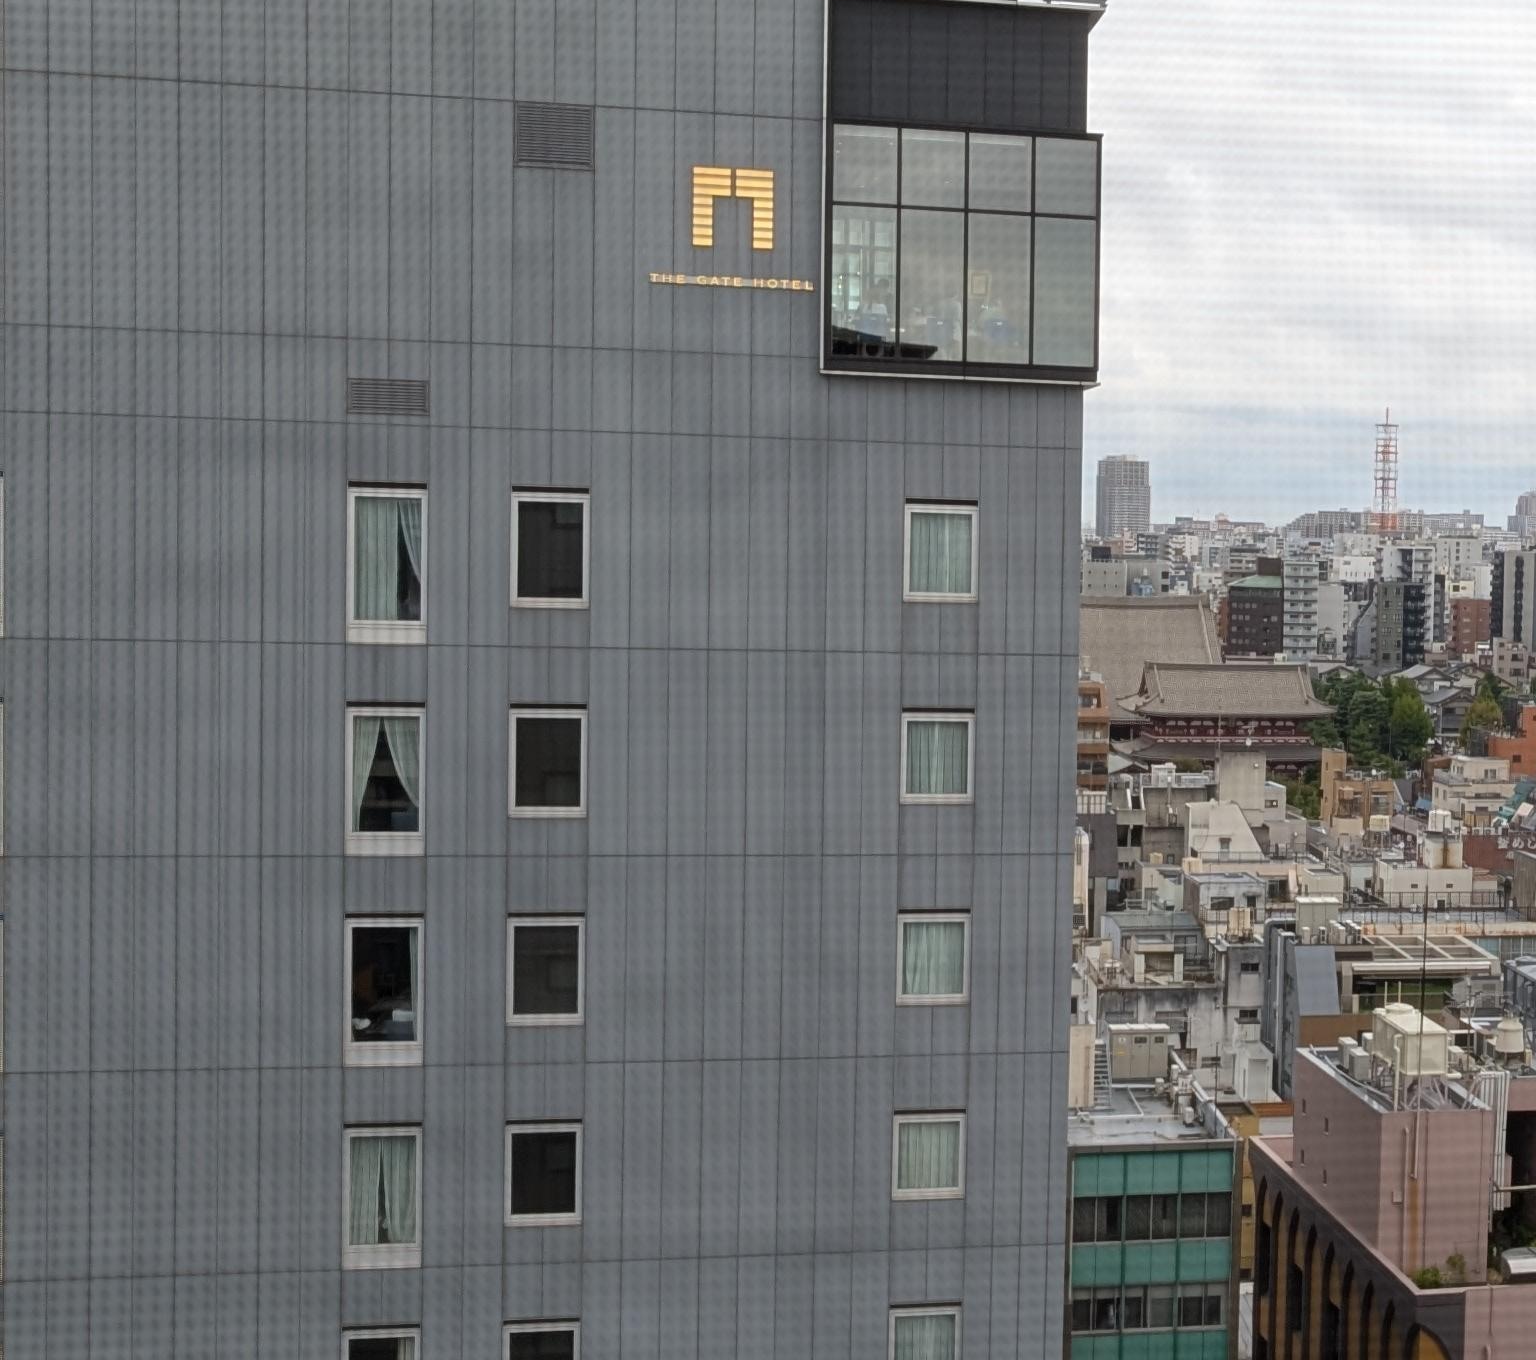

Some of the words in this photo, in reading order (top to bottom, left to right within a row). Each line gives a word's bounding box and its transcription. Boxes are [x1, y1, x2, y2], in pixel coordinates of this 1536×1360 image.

[650, 273, 687, 284] THE
[697, 275, 744, 288] GATE
[753, 278, 814, 291] HOTEL
